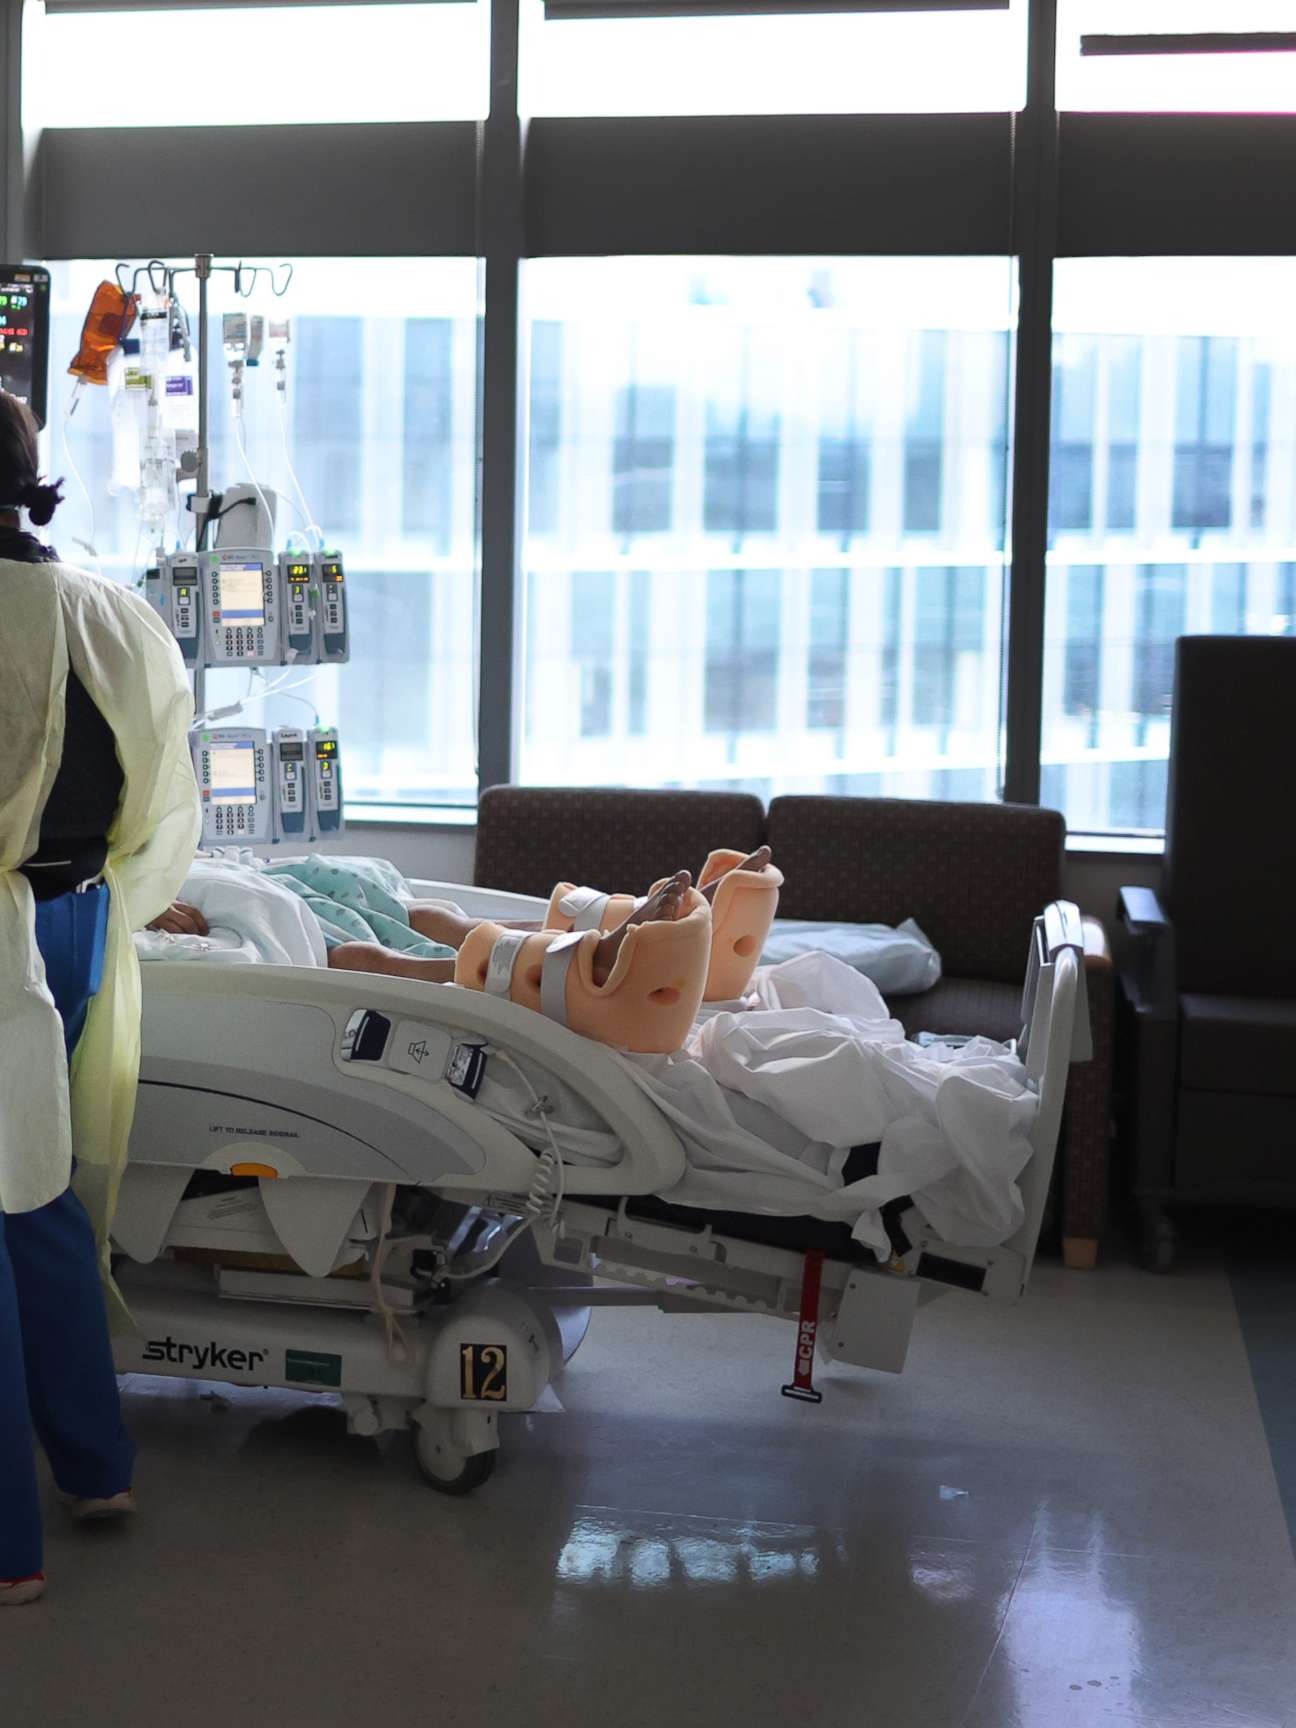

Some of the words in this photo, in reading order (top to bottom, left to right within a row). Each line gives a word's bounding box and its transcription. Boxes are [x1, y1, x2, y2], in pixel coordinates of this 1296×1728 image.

[225, 1126, 235, 1134] TO
[235, 1127, 267, 1136] RELEASE
[142, 1336, 264, 1371] stryker
[799, 1321, 816, 1359] CPR
[461, 1345, 505, 1399] 12
